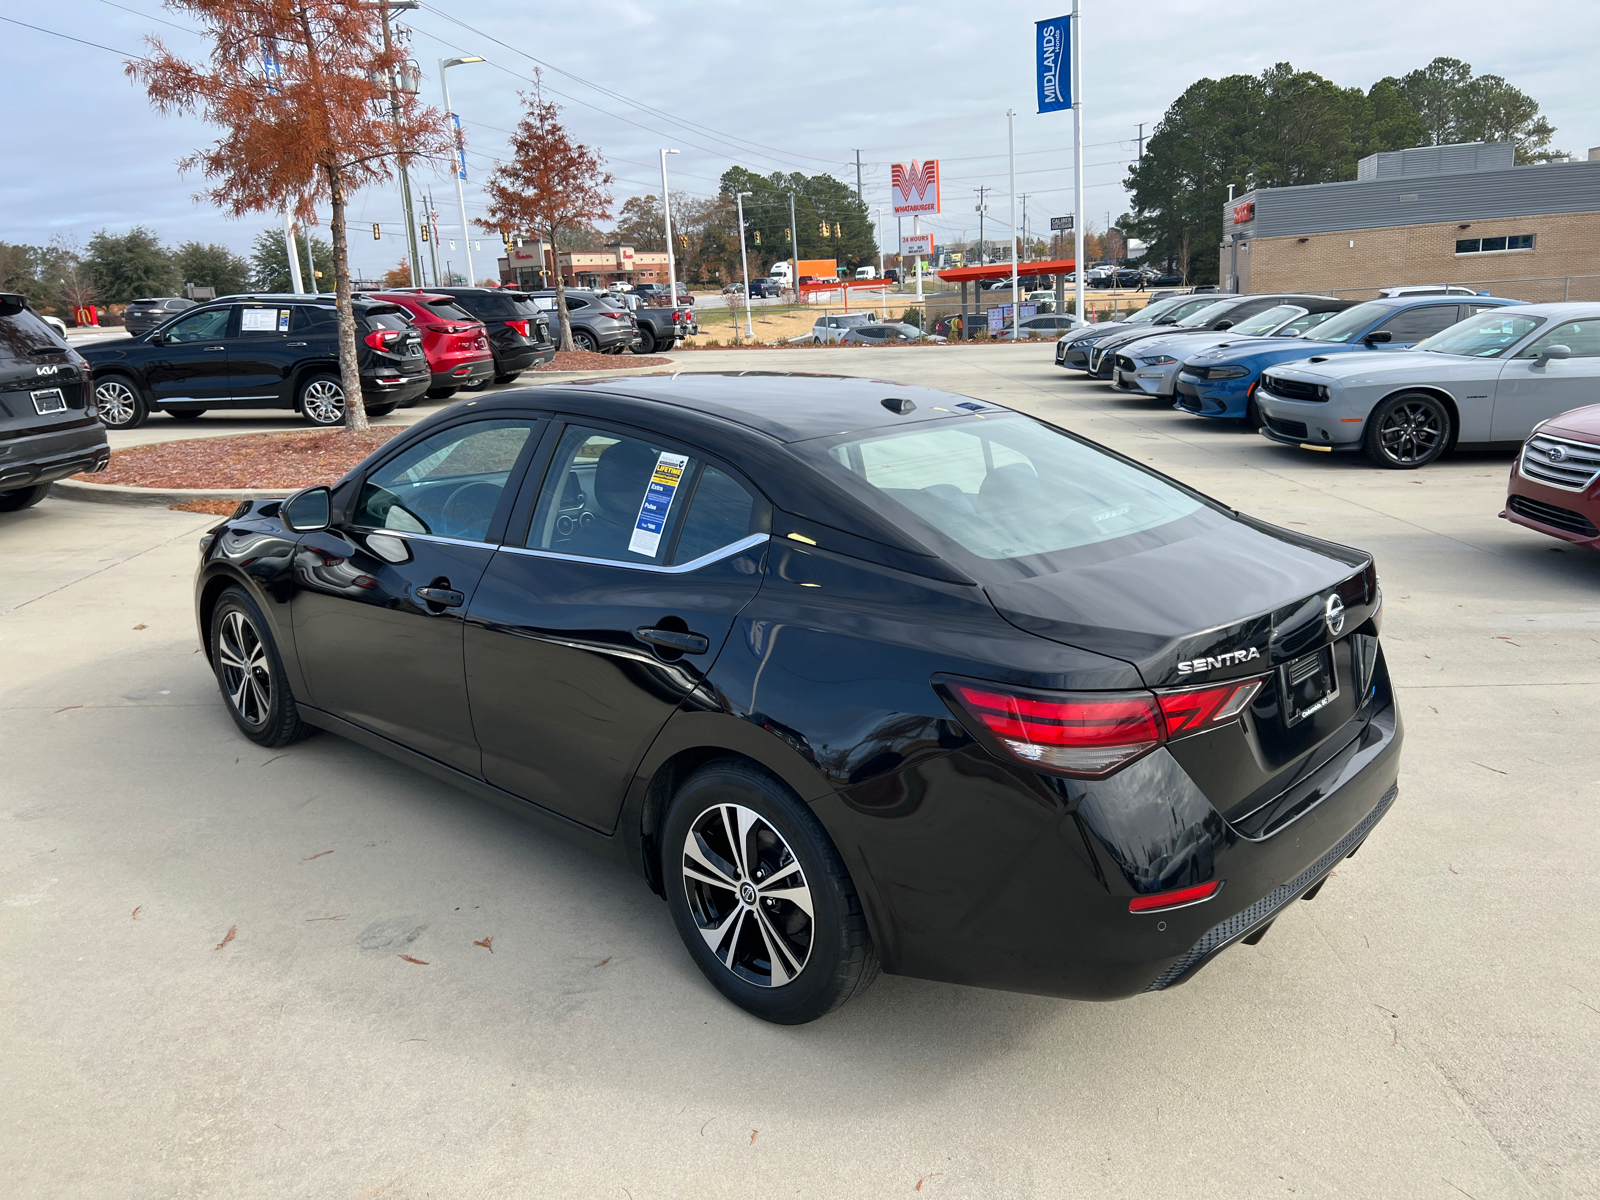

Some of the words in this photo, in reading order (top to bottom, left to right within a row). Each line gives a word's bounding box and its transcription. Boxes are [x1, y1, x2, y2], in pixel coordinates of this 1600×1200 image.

[1043, 25, 1055, 103] MIDLANDS
[894, 203, 935, 213] WHATABURGER
[36, 365, 58, 375] KIA
[657, 465, 683, 475] LIFETIME
[651, 483, 664, 492] Extra
[1177, 646, 1261, 676] SENTRA
